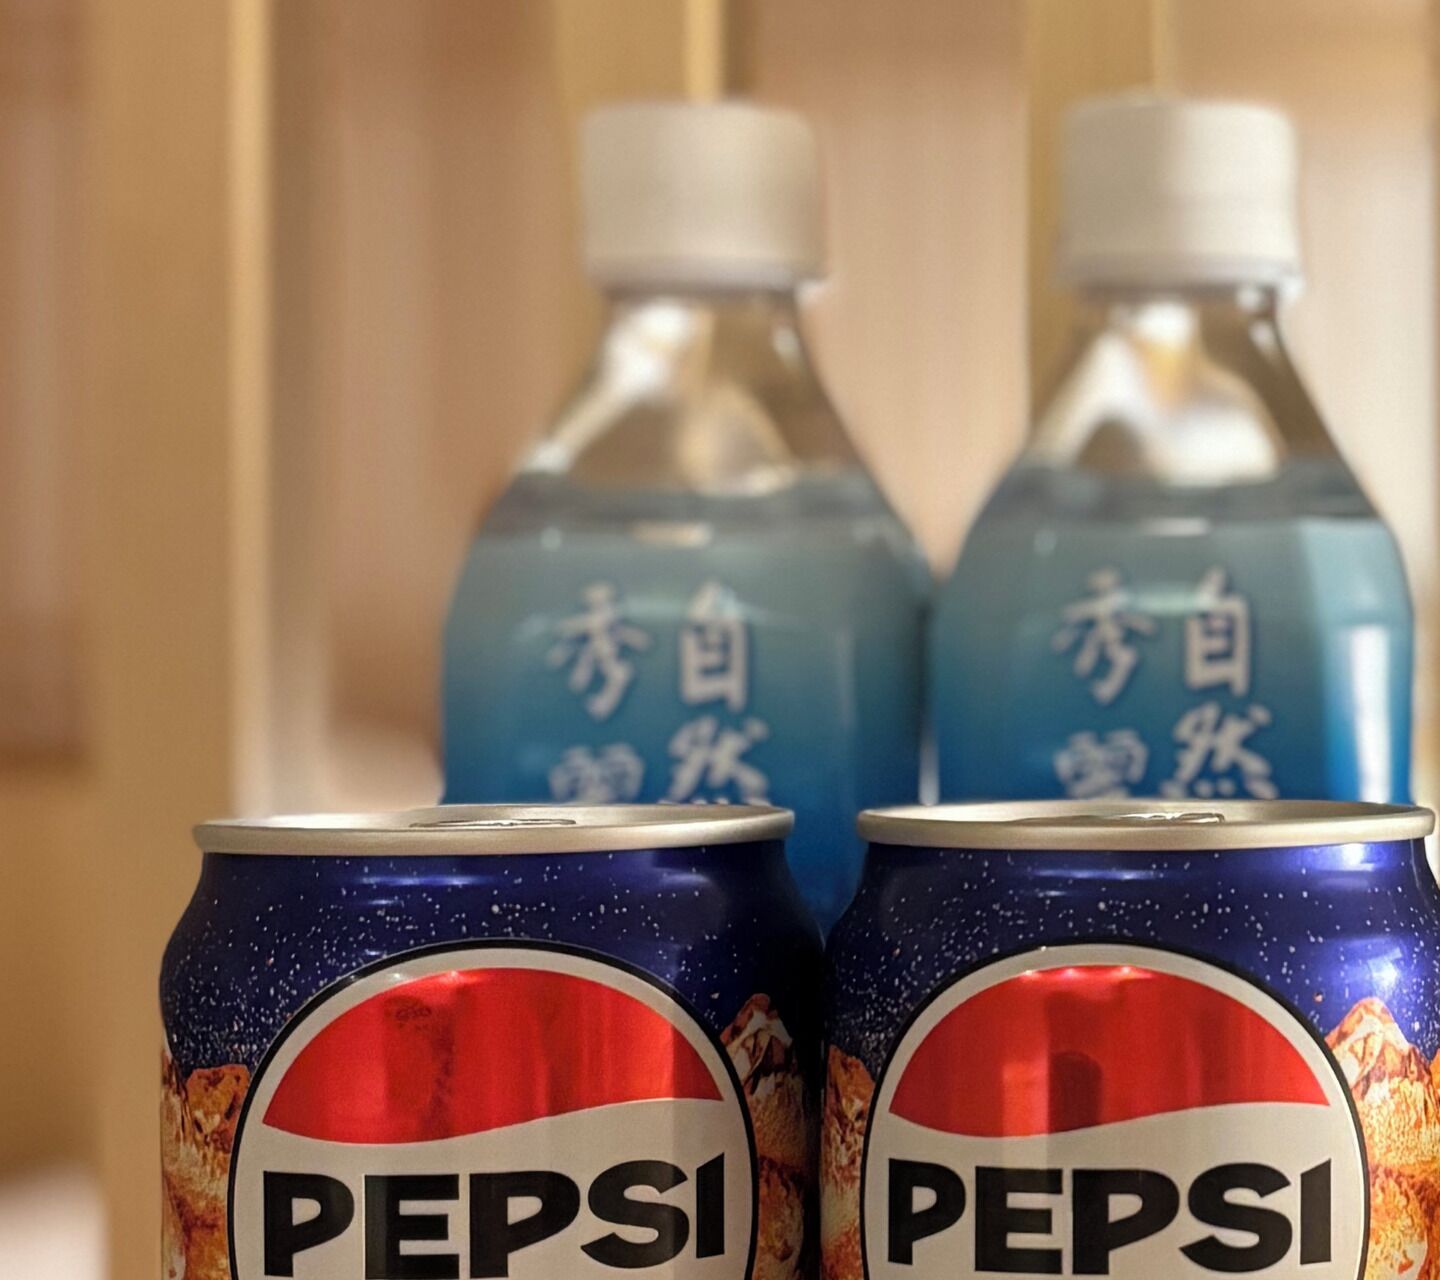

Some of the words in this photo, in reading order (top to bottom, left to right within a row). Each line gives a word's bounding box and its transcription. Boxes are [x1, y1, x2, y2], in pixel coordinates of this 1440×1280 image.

[1162, 564, 1280, 800] 自然
[263, 1153, 725, 1280] PEPSI
[887, 1156, 1332, 1276] PEPSI
